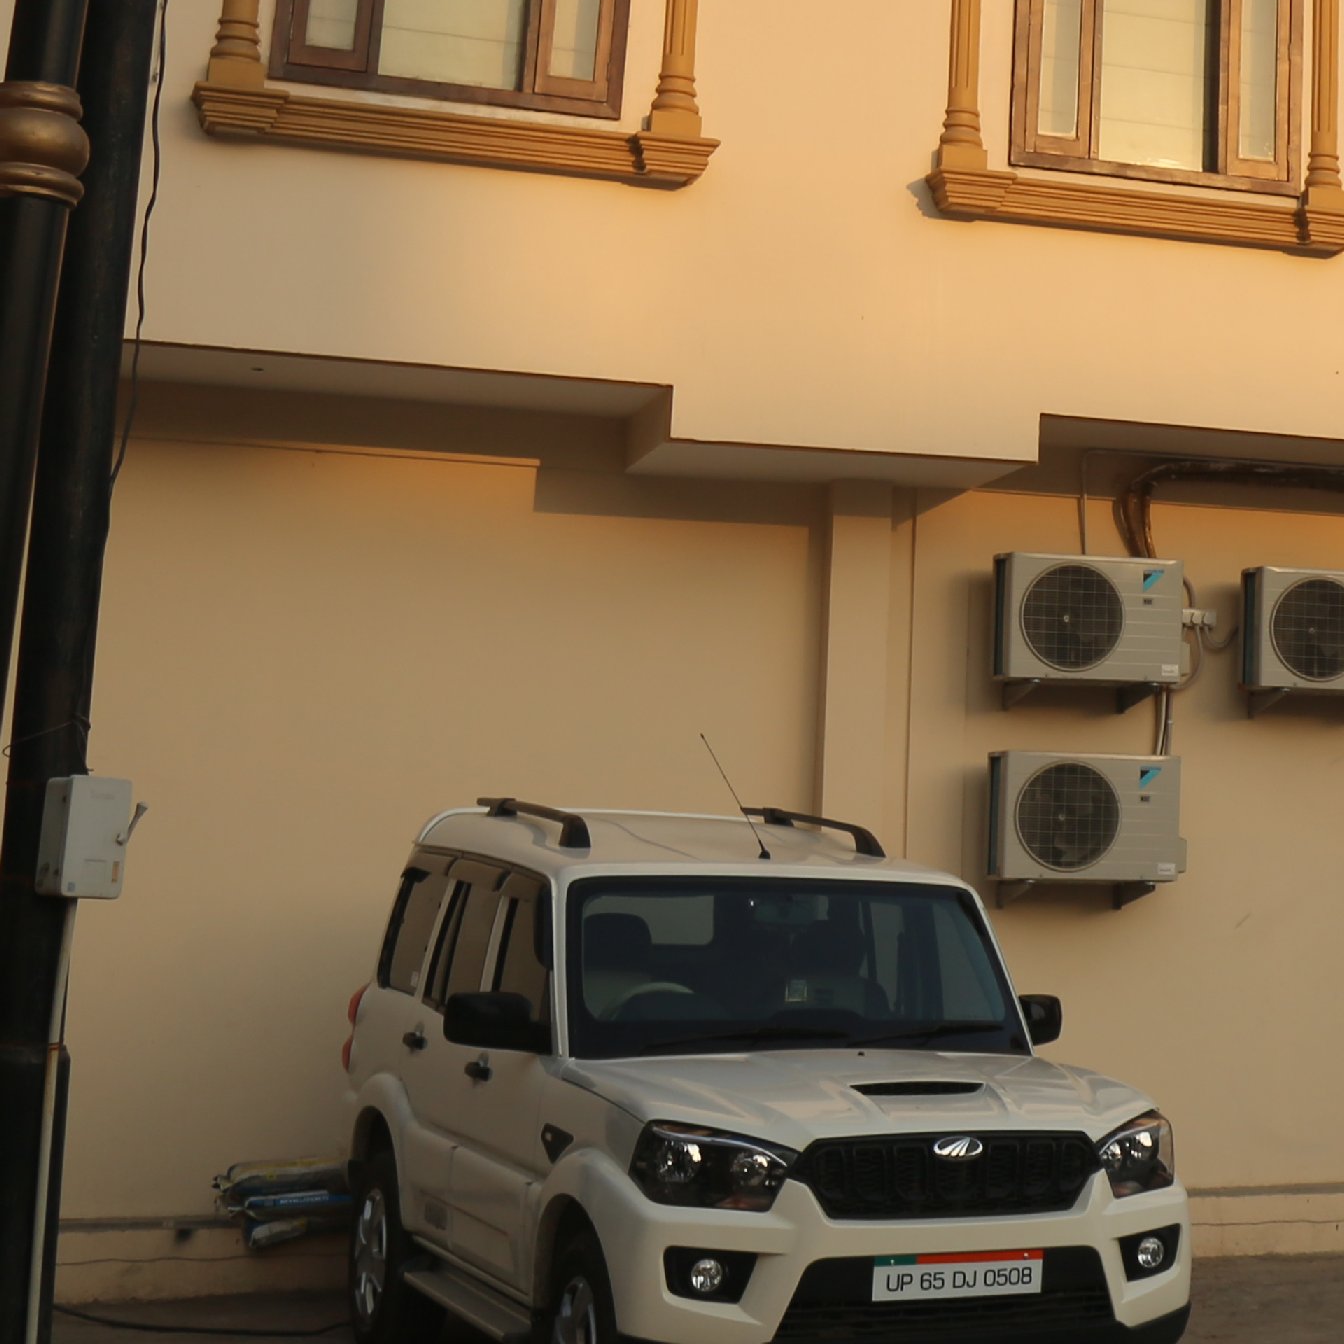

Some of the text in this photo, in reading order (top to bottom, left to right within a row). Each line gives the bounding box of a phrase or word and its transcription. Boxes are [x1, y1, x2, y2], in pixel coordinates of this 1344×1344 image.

[886, 1267, 1032, 1292] UP 65 DJ 0508
